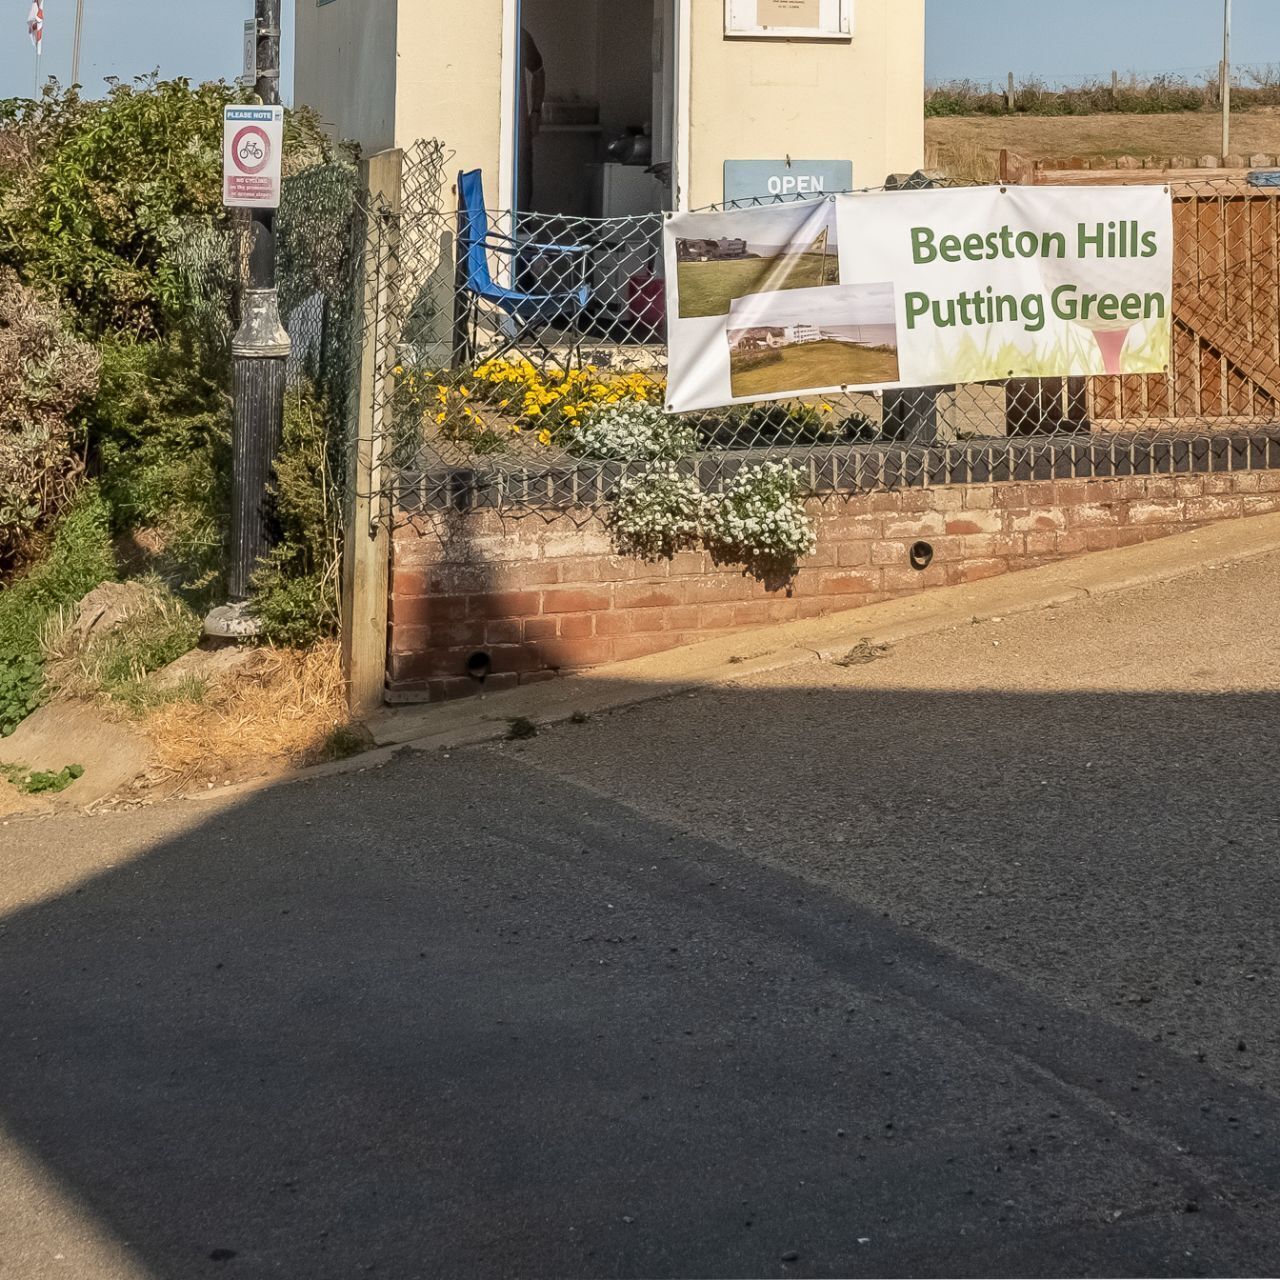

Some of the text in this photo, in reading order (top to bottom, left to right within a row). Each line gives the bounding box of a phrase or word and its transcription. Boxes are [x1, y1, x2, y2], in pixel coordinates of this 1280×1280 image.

[227, 110, 272, 120] PLEASE NOTE
[767, 175, 824, 195] OPEN
[911, 220, 1158, 264] Beeston Hills
[905, 284, 1165, 332] Putting Green
